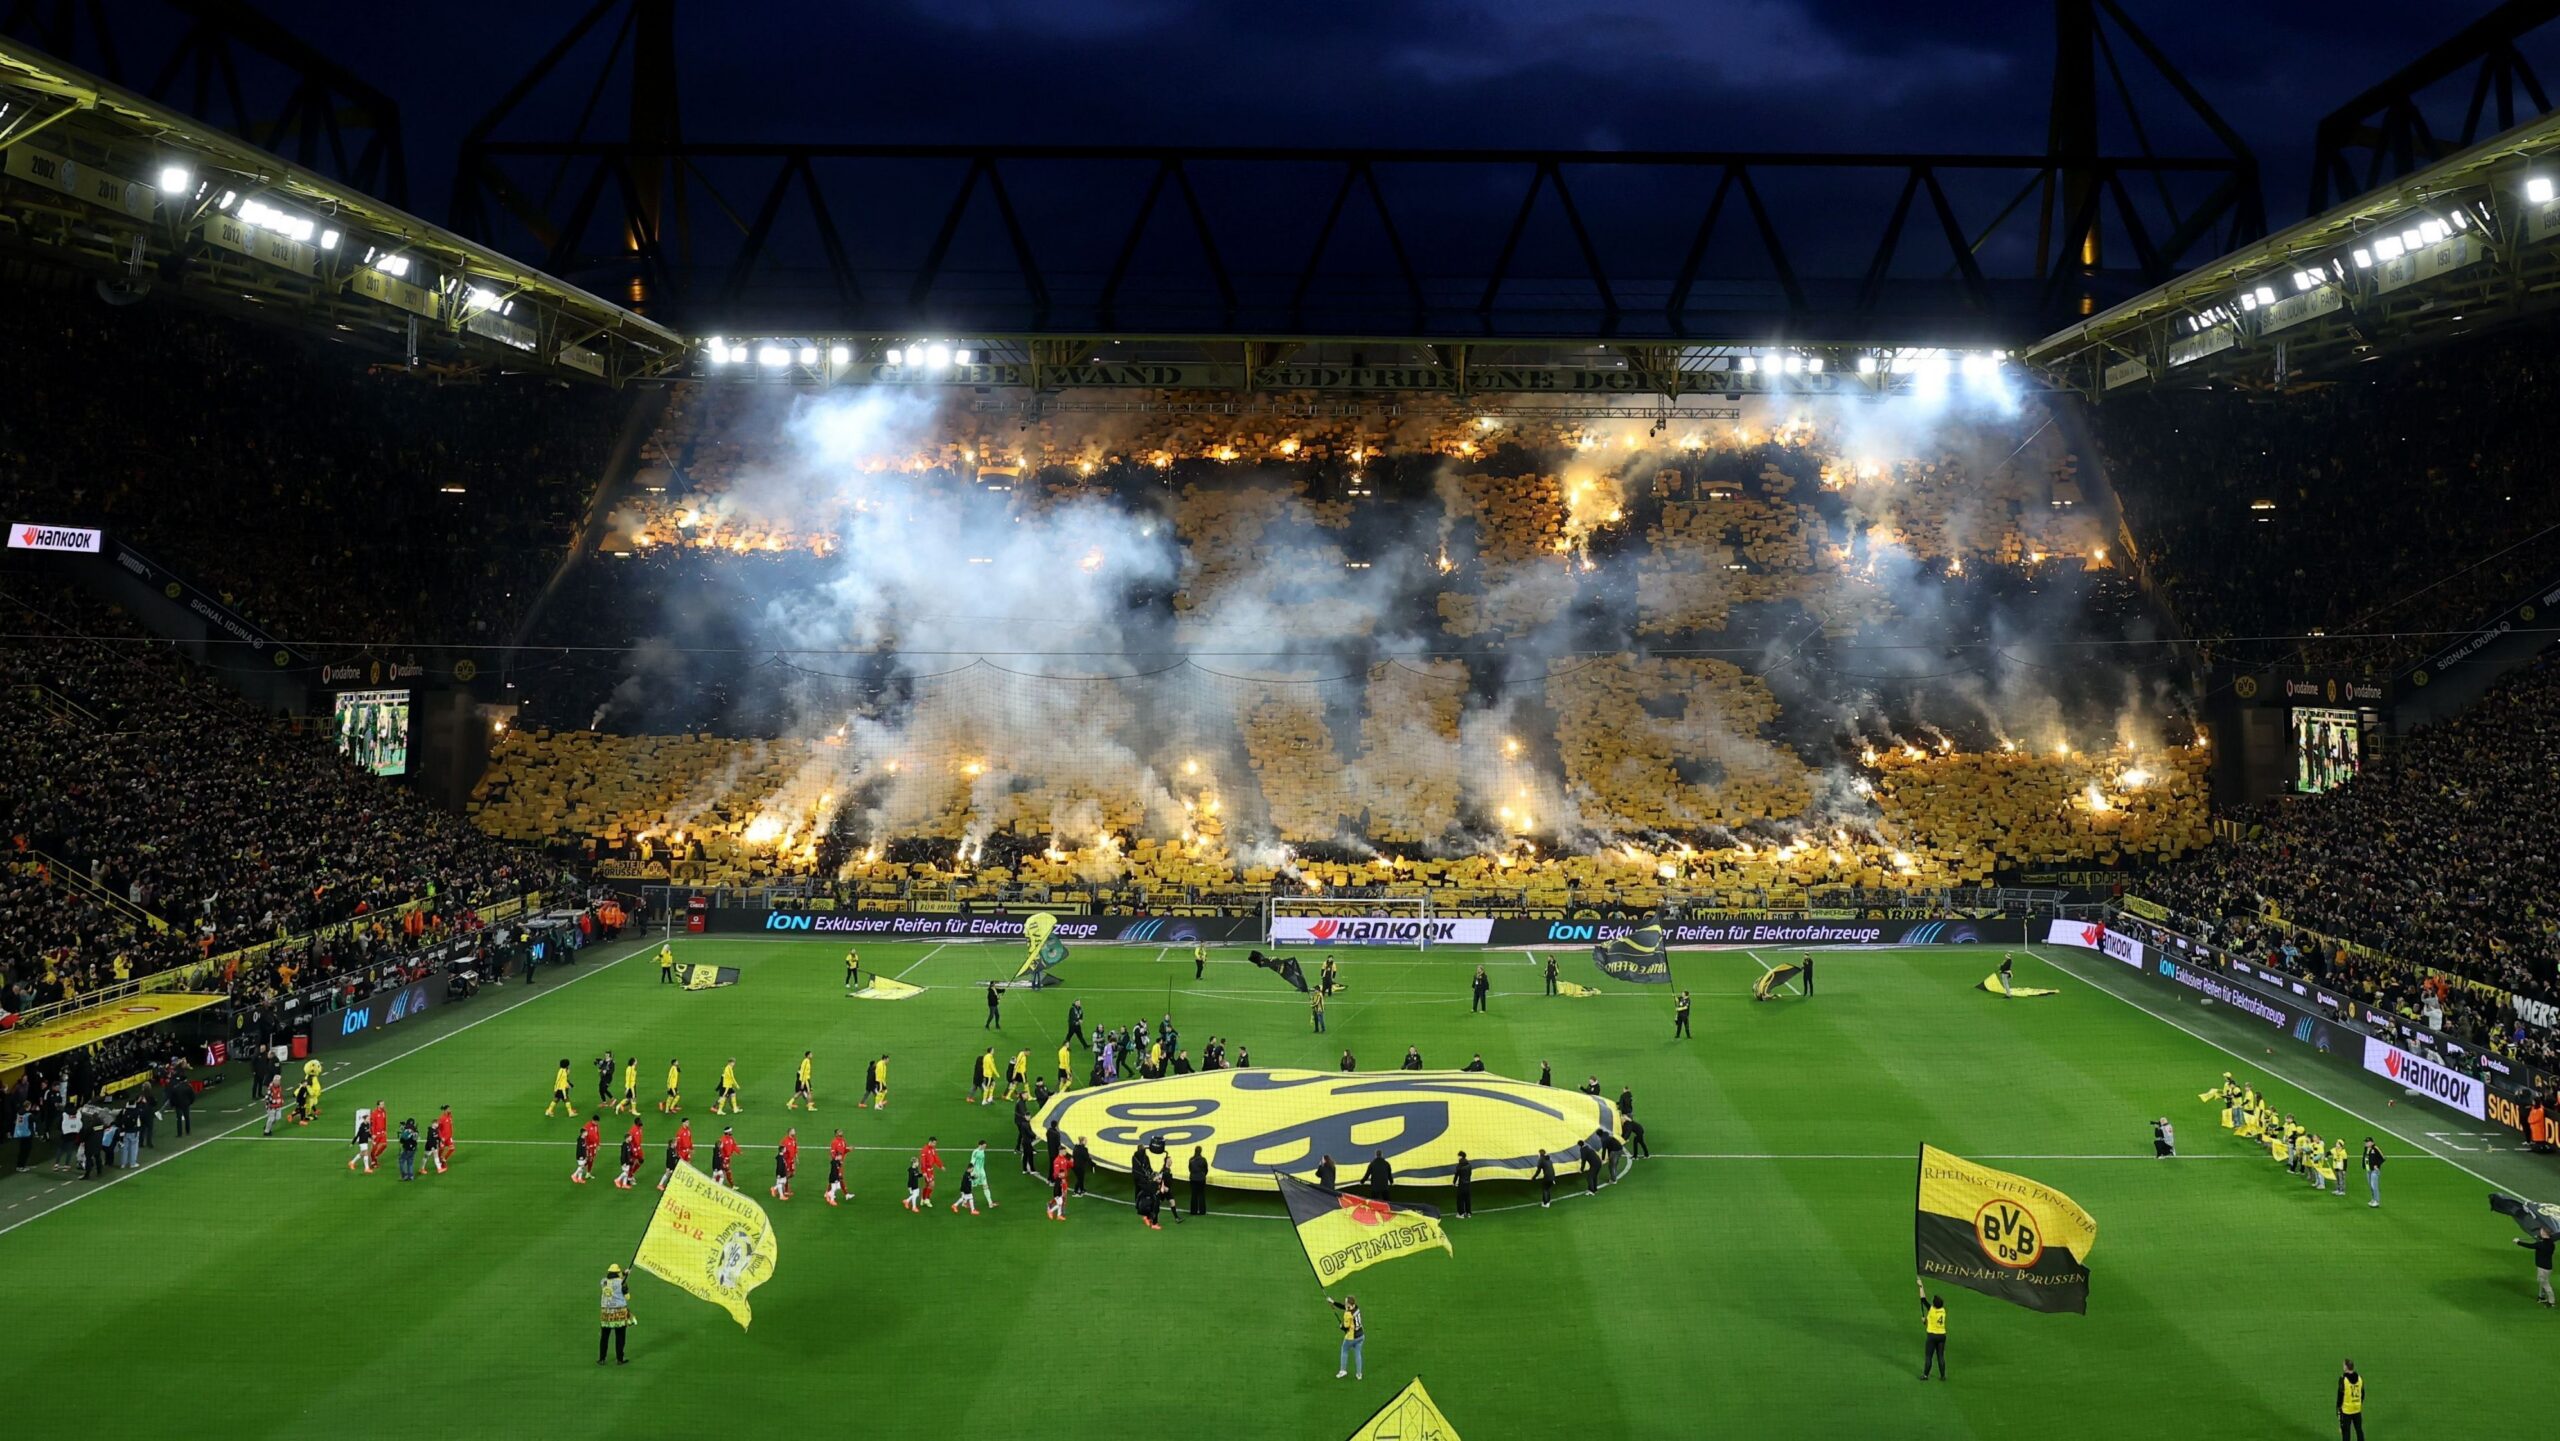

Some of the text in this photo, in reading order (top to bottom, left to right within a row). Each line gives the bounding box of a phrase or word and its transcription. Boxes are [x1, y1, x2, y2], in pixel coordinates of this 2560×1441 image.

[32, 155, 118, 201] 2002 2011
[223, 224, 240, 244] 2012
[1048, 366, 1182, 384] WAND
[190, 598, 254, 643] SIGNAL IDUNA
[2437, 628, 2502, 671] SIGNAL IDUNA
[332, 665, 361, 680] vodafone
[2294, 681, 2319, 697] vodafone
[2354, 684, 2382, 700] vodafone
[598, 861, 646, 869] RNSTEIG
[936, 903, 962, 912] IMME
[814, 917, 891, 932] Exklusiver
[892, 918, 943, 933] Reifen
[944, 919, 968, 934] für
[970, 918, 1098, 938] Elektrozeuge
[1597, 924, 1673, 941] Exkler
[1675, 924, 1726, 941] Reifen
[1727, 925, 1751, 942] für
[1753, 924, 1881, 943] Elektrofahrzeuge
[2102, 933, 2133, 961] ANKOOK
[2175, 965, 2203, 990] Exklusiver
[2203, 977, 2223, 999] Reifen
[2222, 983, 2232, 1003] für
[2232, 987, 2286, 1029] Elektrofahrzeuge
[2512, 994, 2560, 1028] MOERS
[2488, 1058, 2510, 1075] vodafone
[675, 1168, 753, 1218] BVB FANCLUB
[1924, 1167, 2097, 1234] RHEINISCHER FANCLUB
[664, 1197, 691, 1221] Heja
[1984, 1205, 2035, 1255] BVB
[1999, 1244, 2018, 1261] 09
[2016, 1268, 2086, 1286] BORUSSEN
